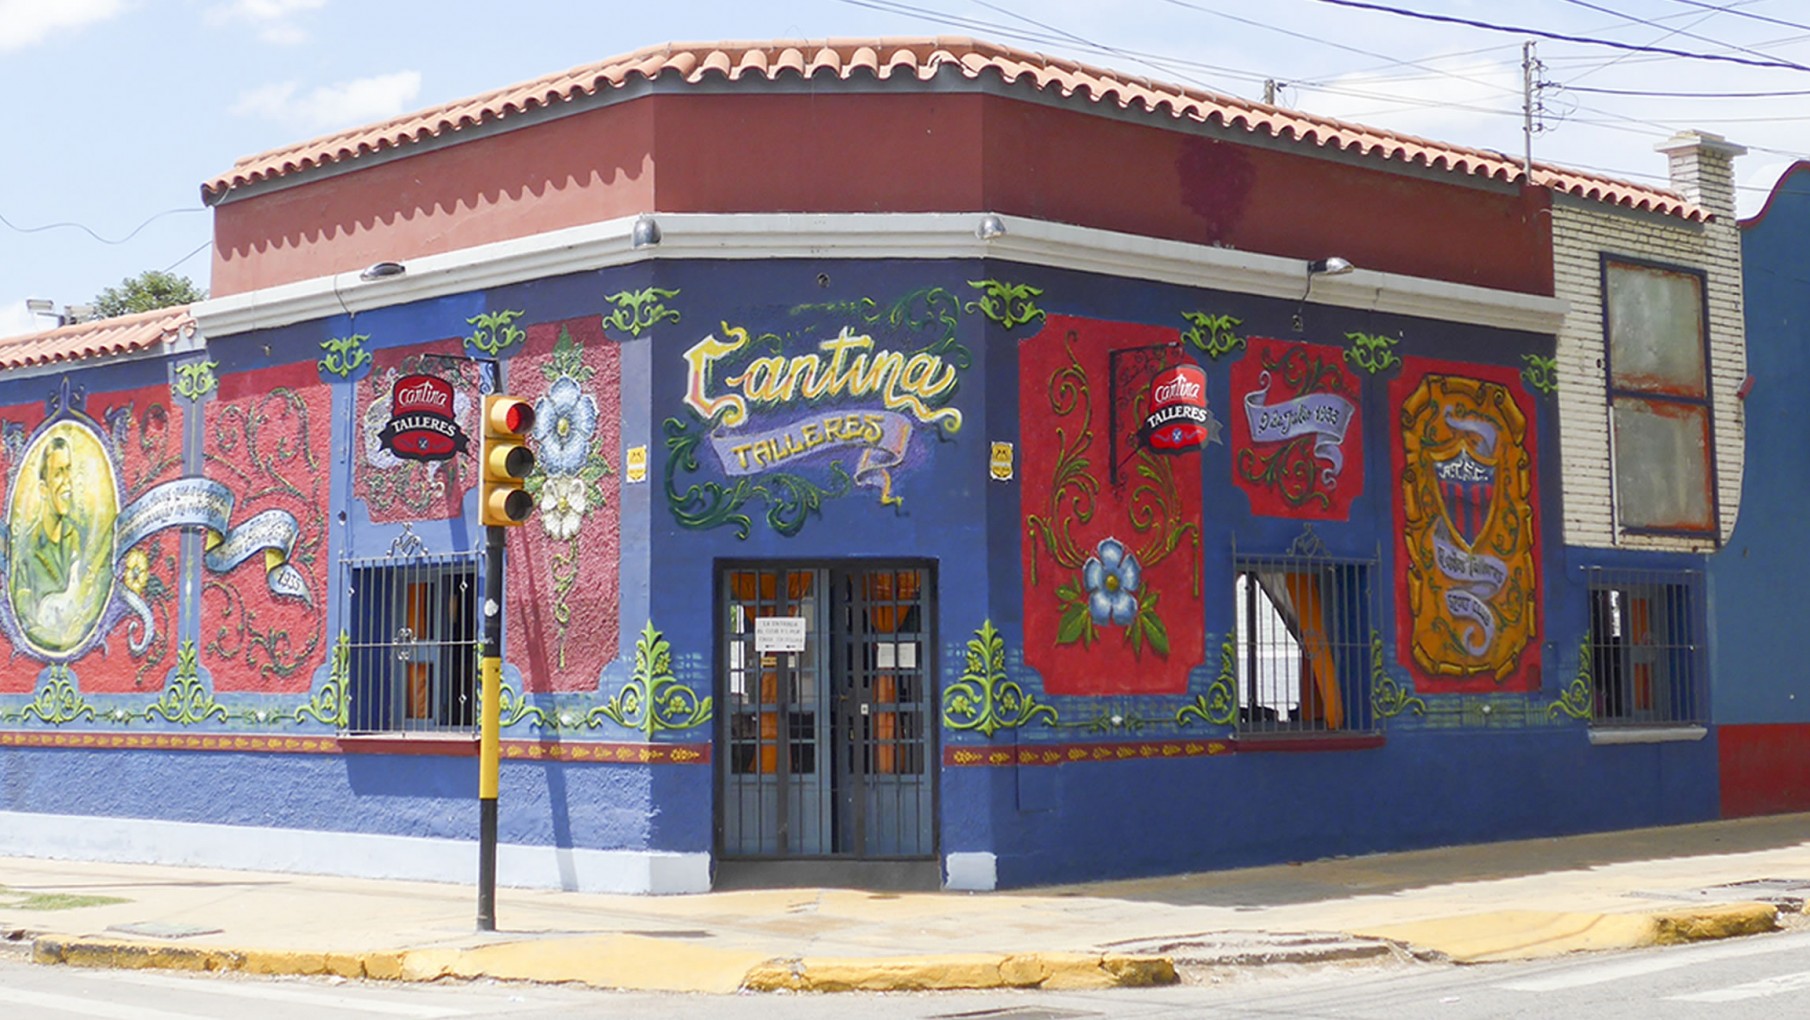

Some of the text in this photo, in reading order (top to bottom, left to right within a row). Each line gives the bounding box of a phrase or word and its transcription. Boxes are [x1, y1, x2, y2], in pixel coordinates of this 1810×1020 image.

[683, 320, 962, 433] Cantina
[391, 416, 456, 437] TALLERES
[1147, 405, 1207, 428] TALLERES
[1258, 411, 1269, 434] 9
[731, 414, 884, 470] TALLERES
